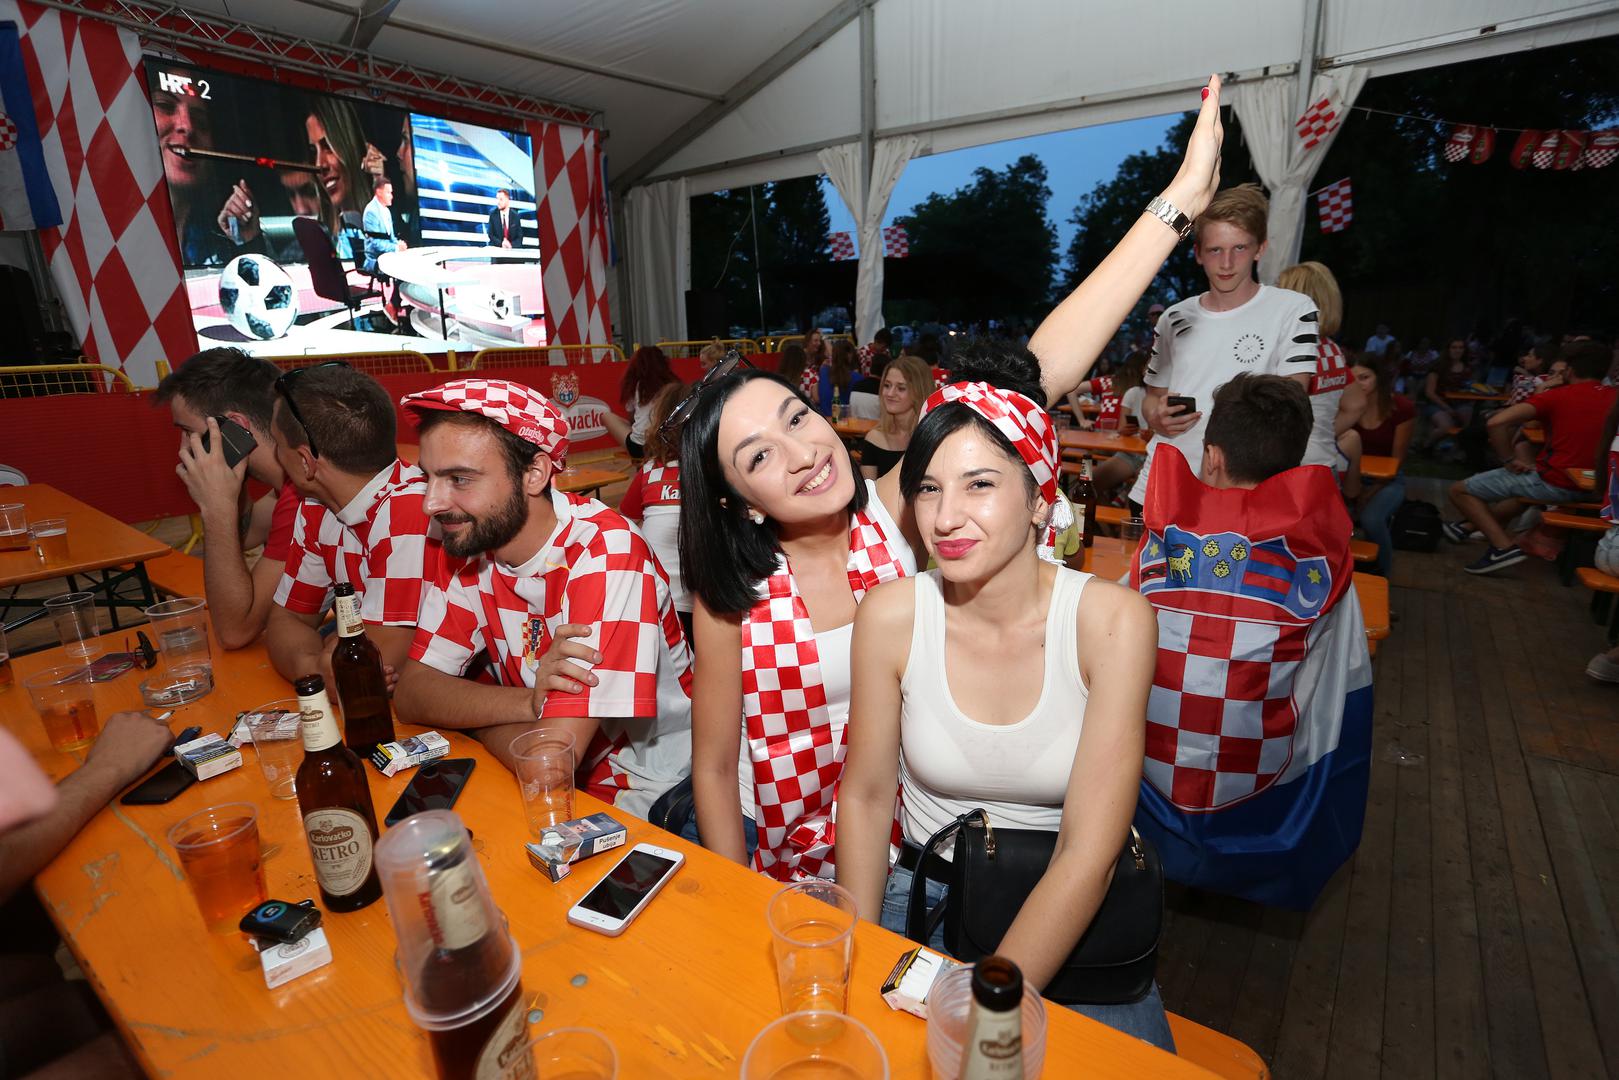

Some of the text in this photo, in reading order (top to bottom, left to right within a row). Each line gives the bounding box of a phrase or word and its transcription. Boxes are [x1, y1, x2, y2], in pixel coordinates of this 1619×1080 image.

[158, 71, 212, 100] HRT 2
[660, 485, 681, 500] Ka
[311, 841, 360, 861] RETRO
